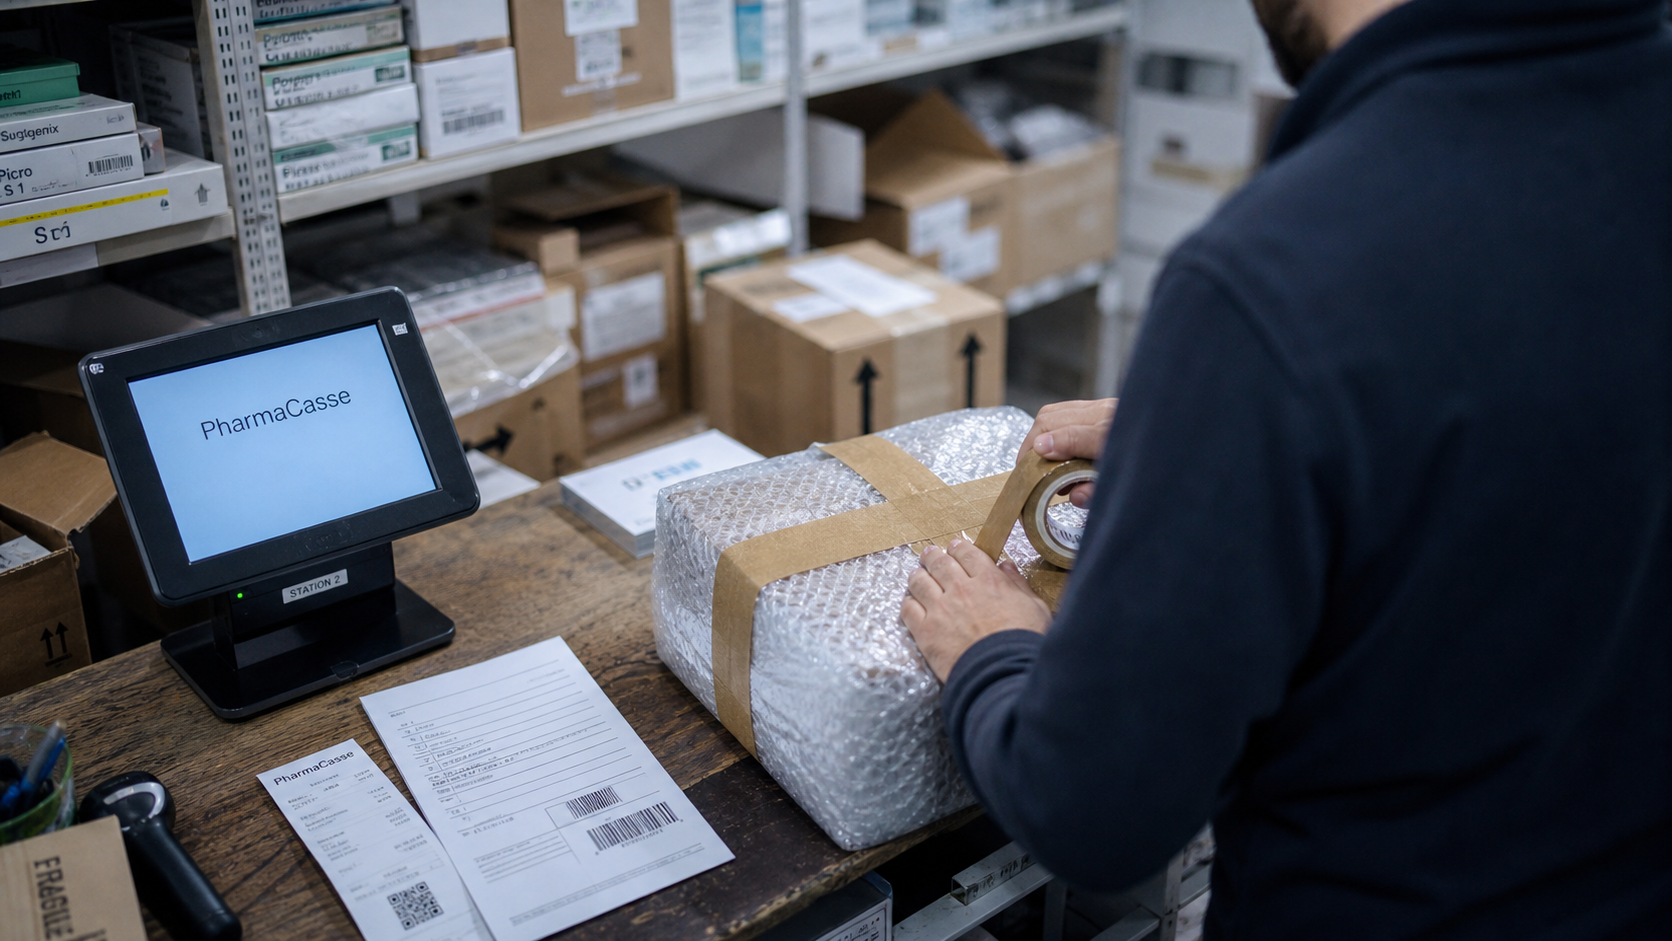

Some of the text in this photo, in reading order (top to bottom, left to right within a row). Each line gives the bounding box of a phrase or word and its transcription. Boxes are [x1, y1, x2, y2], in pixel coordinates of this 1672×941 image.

[201, 390, 351, 440] PharmaCasse
[290, 575, 341, 598] STATION 2
[273, 751, 354, 786] PharmaCasse
